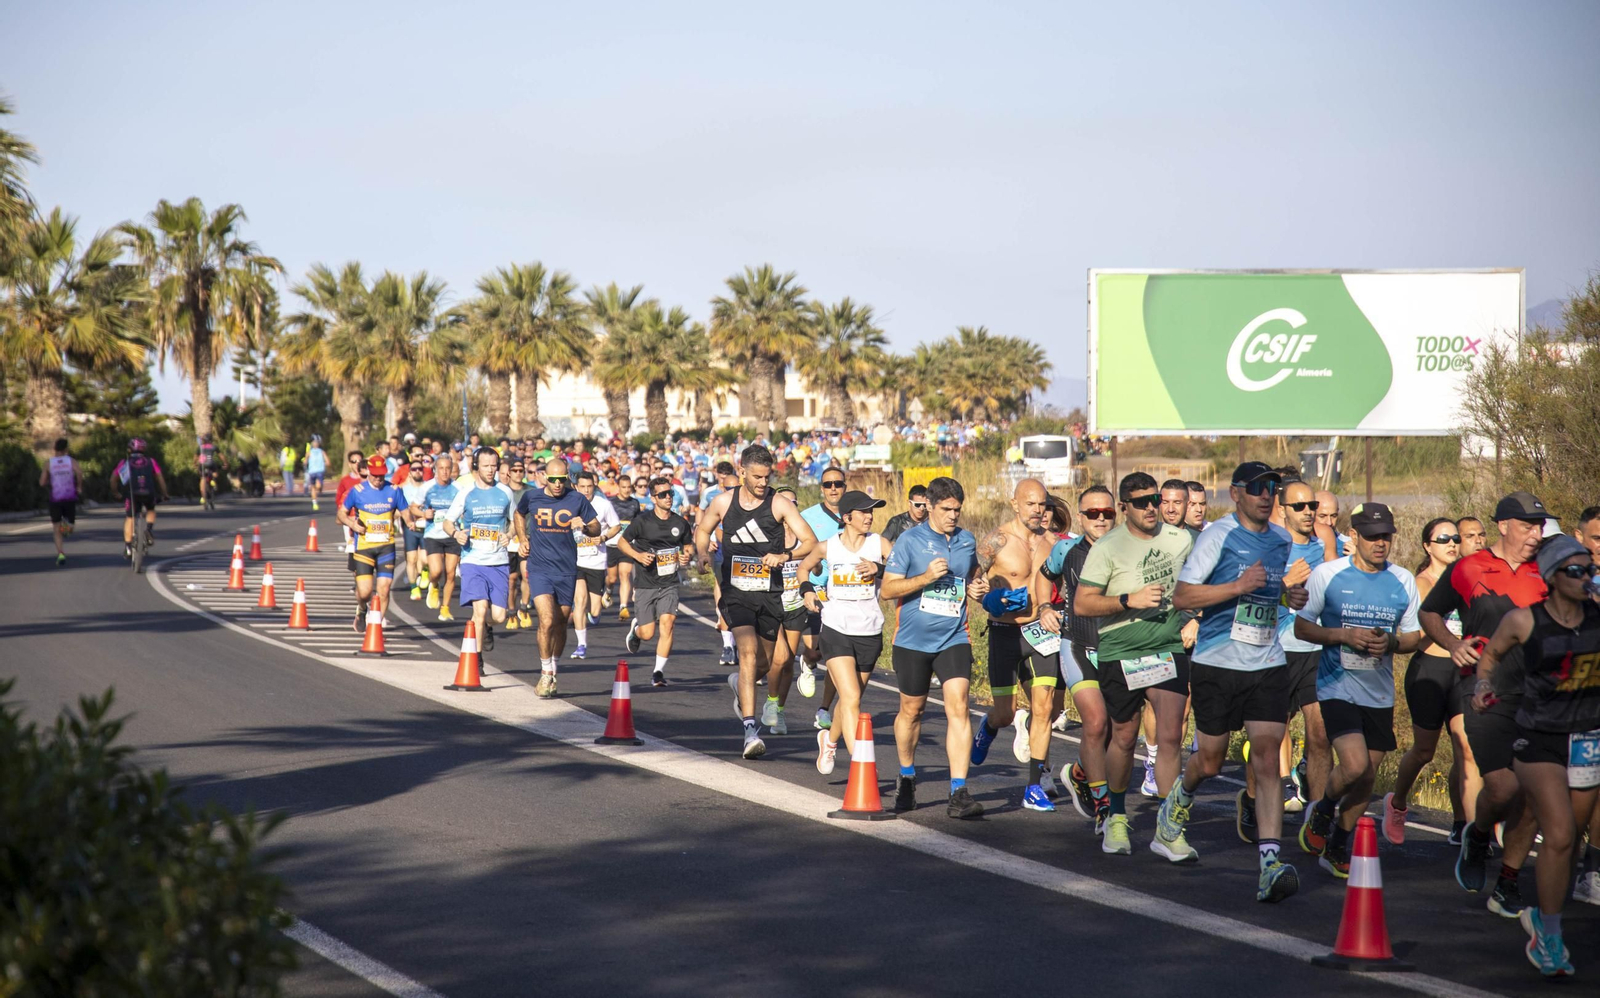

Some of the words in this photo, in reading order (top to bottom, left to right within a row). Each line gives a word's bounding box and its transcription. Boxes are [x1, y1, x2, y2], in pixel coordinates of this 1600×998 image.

[1244, 333, 1318, 363] CSIF
[1417, 354, 1475, 372] TOD@S
[1296, 367, 1333, 377] Almería
[371, 523, 386, 532] 899
[474, 529, 497, 538] 1837
[740, 563, 763, 575] 262
[933, 583, 958, 596] 579
[1244, 604, 1275, 621] 1012
[1341, 603, 1366, 611] Medio
[1367, 604, 1397, 613] Maratón
[1341, 609, 1374, 618] Almería
[1374, 611, 1396, 621] 2025
